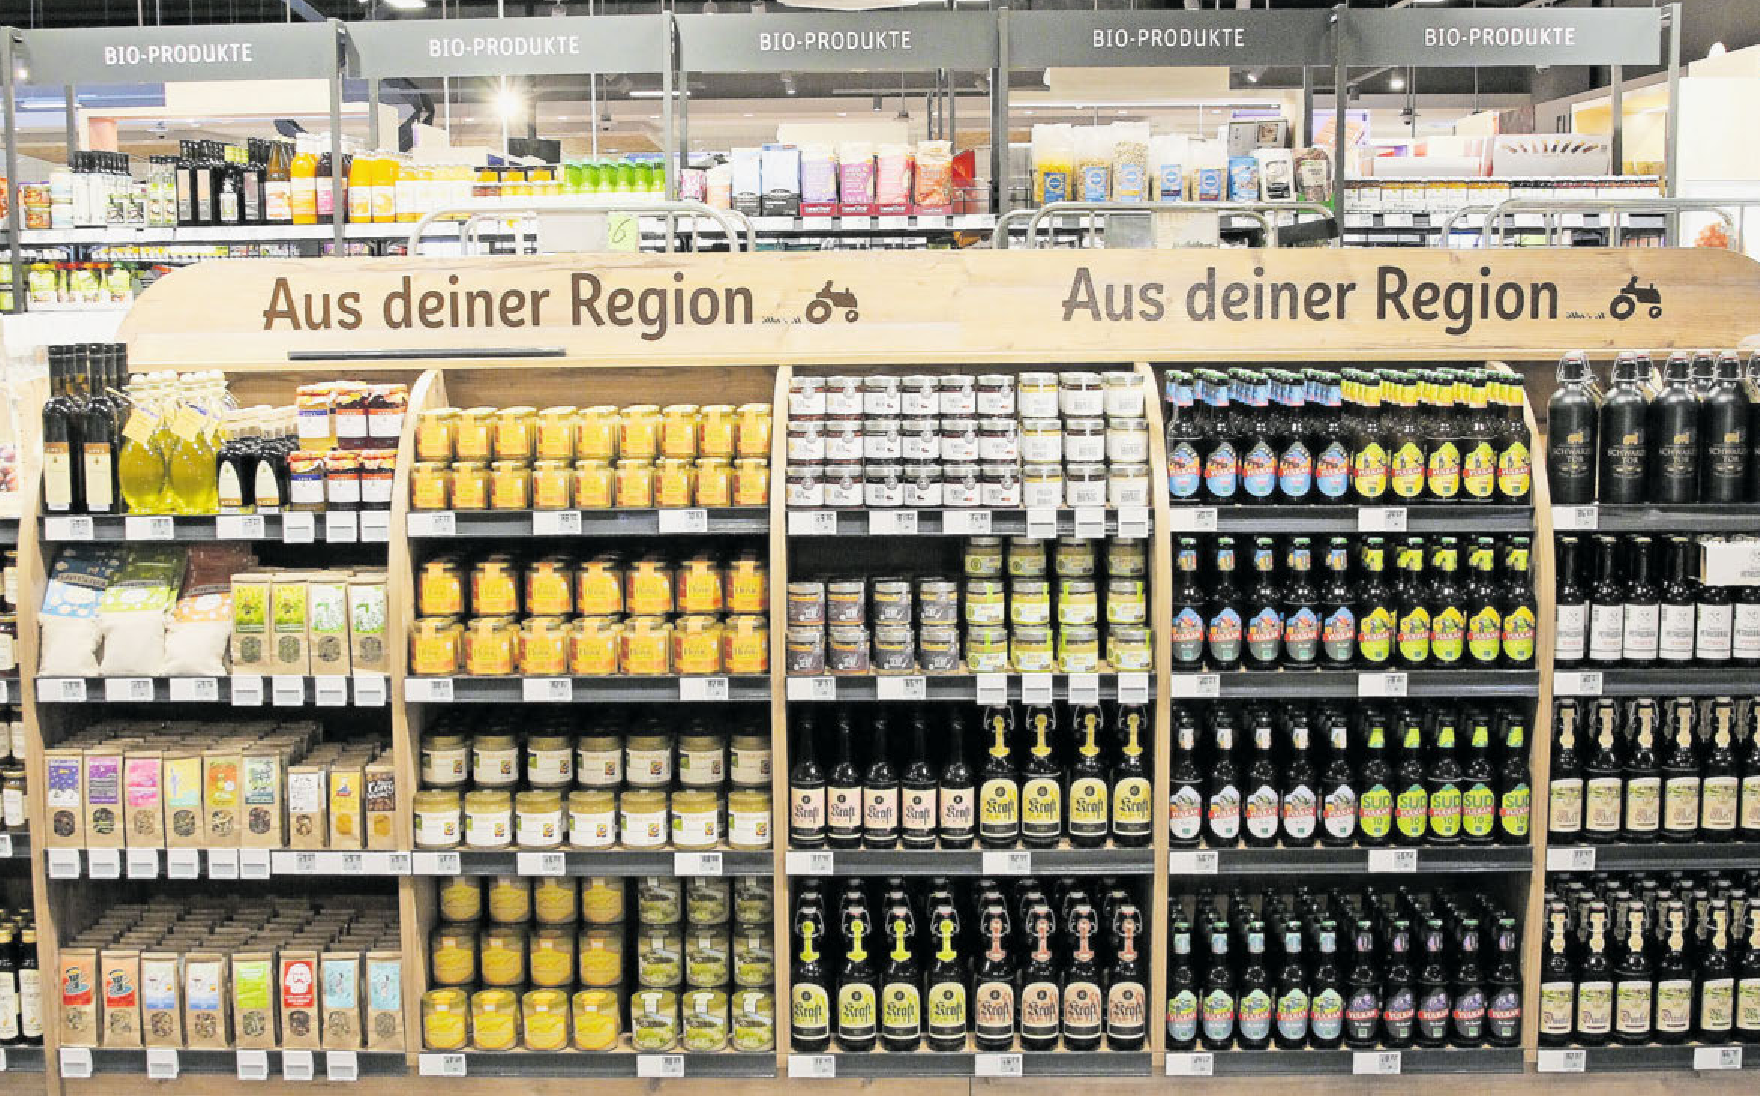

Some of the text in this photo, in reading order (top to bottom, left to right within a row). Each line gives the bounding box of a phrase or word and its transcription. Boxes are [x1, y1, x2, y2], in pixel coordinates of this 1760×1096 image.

[430, 36, 580, 56] BIO-PRODUKTE
[760, 31, 912, 51] BIO-PRODUKTE
[1093, 28, 1246, 48] BIO-PRODUKTE
[1425, 27, 1576, 47] BIO-PRODUKTE
[104, 43, 252, 65] BIO-PRODUKTE
[263, 272, 753, 341] Aus deiner Region
[1063, 266, 1558, 335] Aus deiner Region
